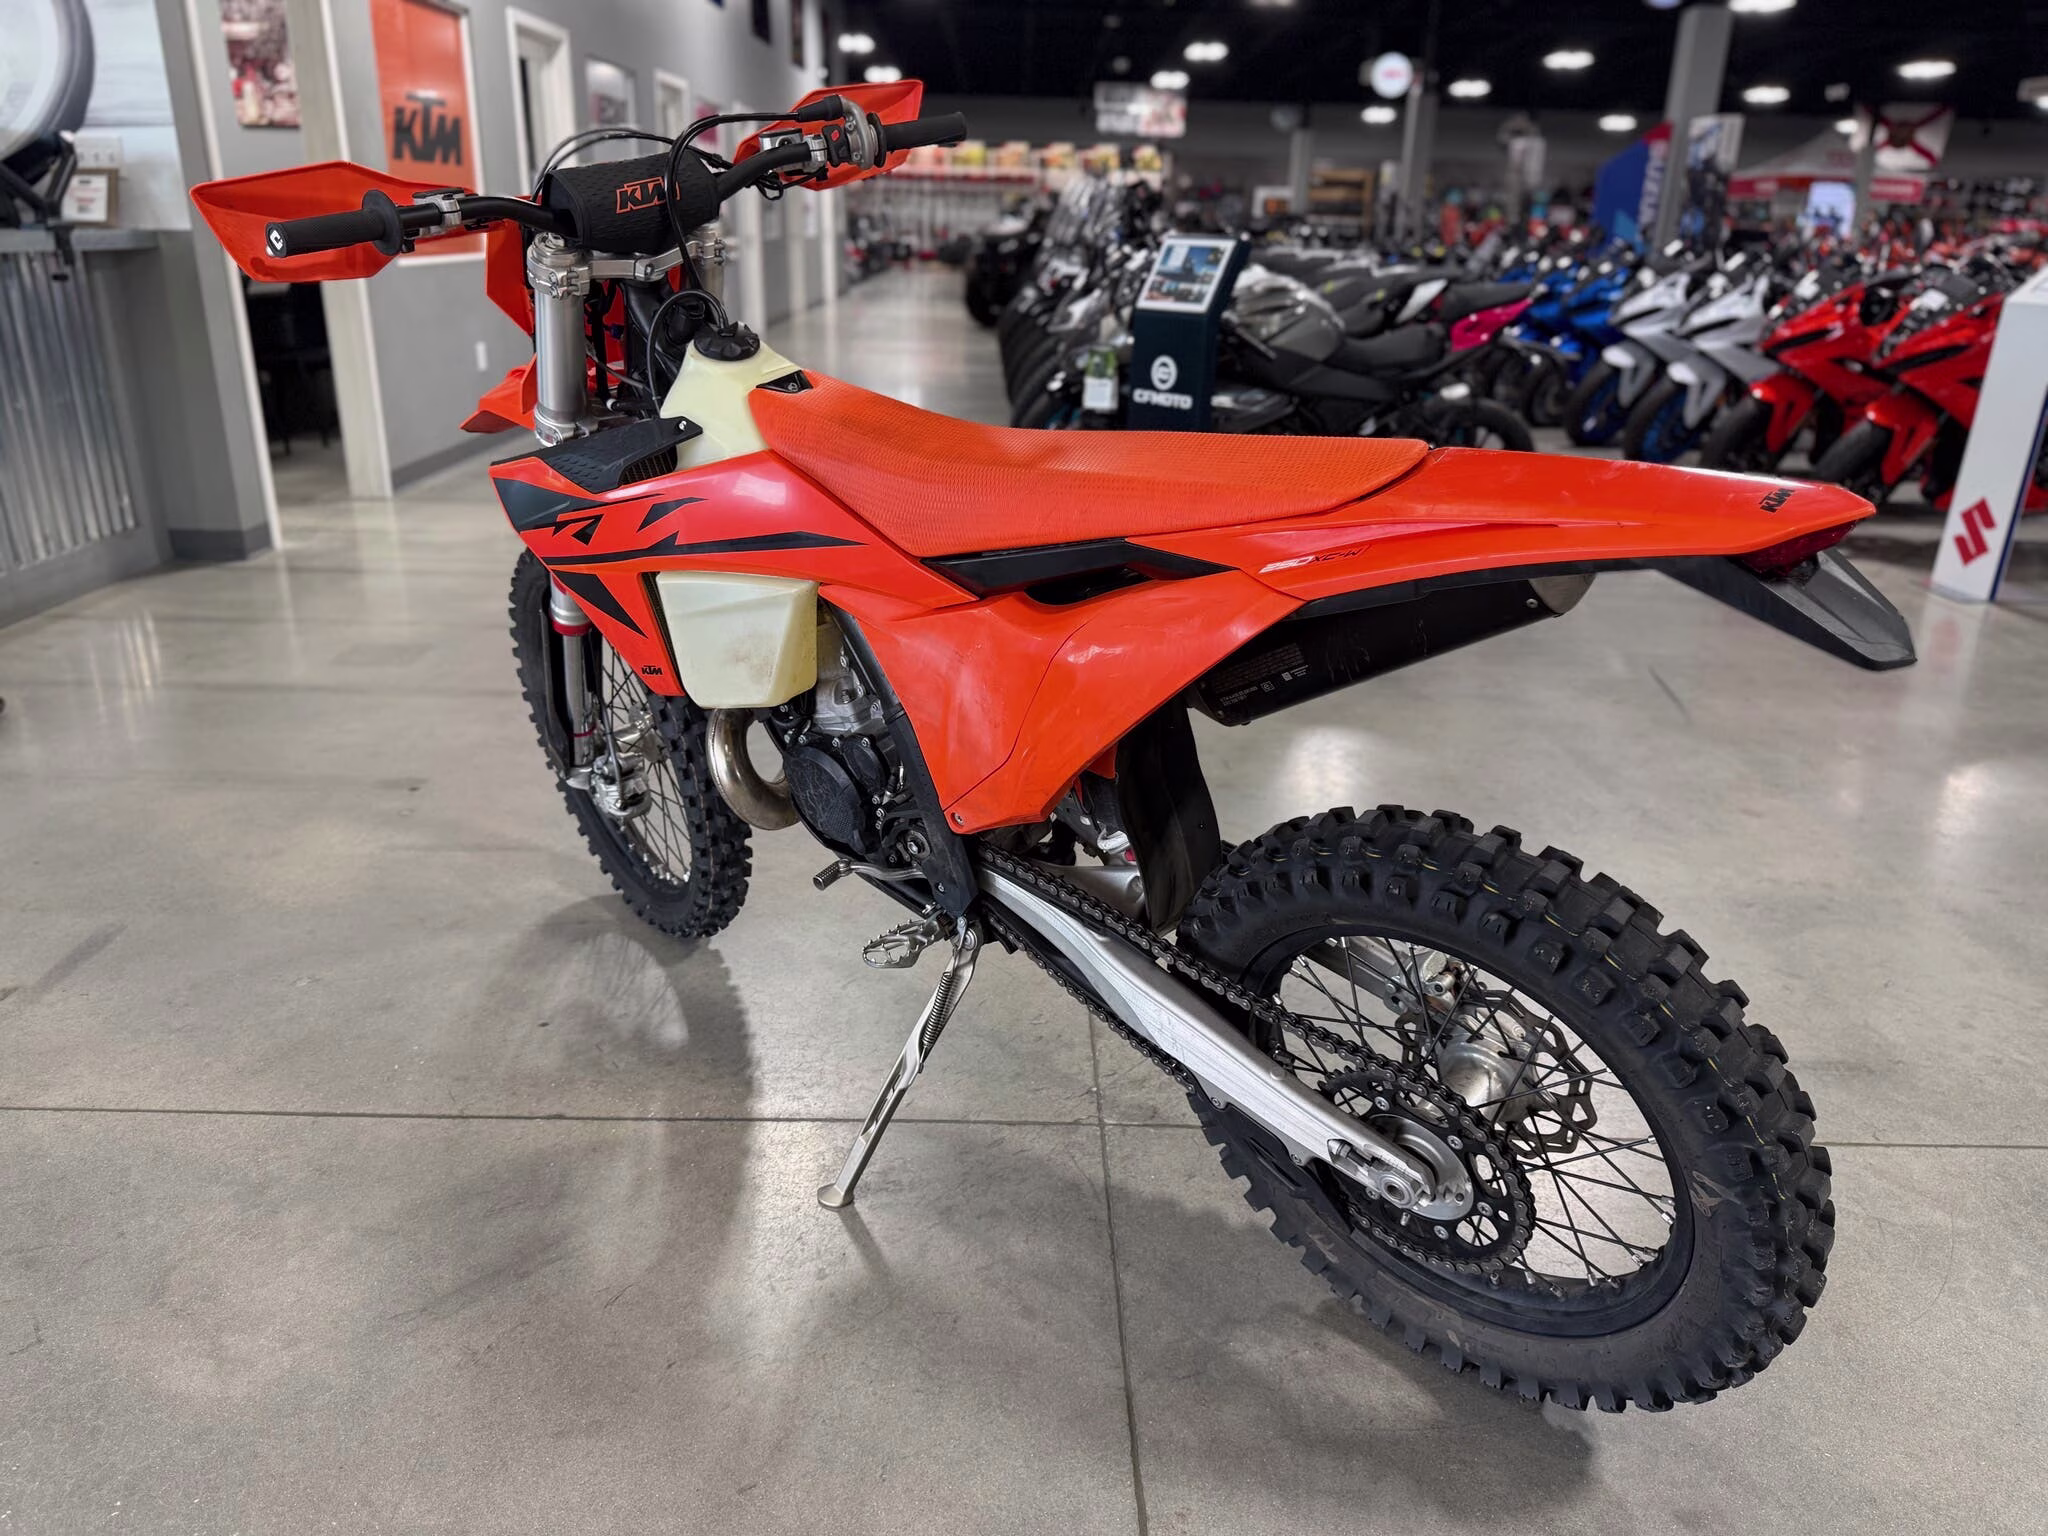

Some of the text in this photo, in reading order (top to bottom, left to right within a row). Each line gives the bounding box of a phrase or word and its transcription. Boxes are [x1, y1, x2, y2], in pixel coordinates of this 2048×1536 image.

[392, 91, 463, 166] KTM
[1758, 487, 1795, 513] KTM
[641, 664, 663, 675] KTM
